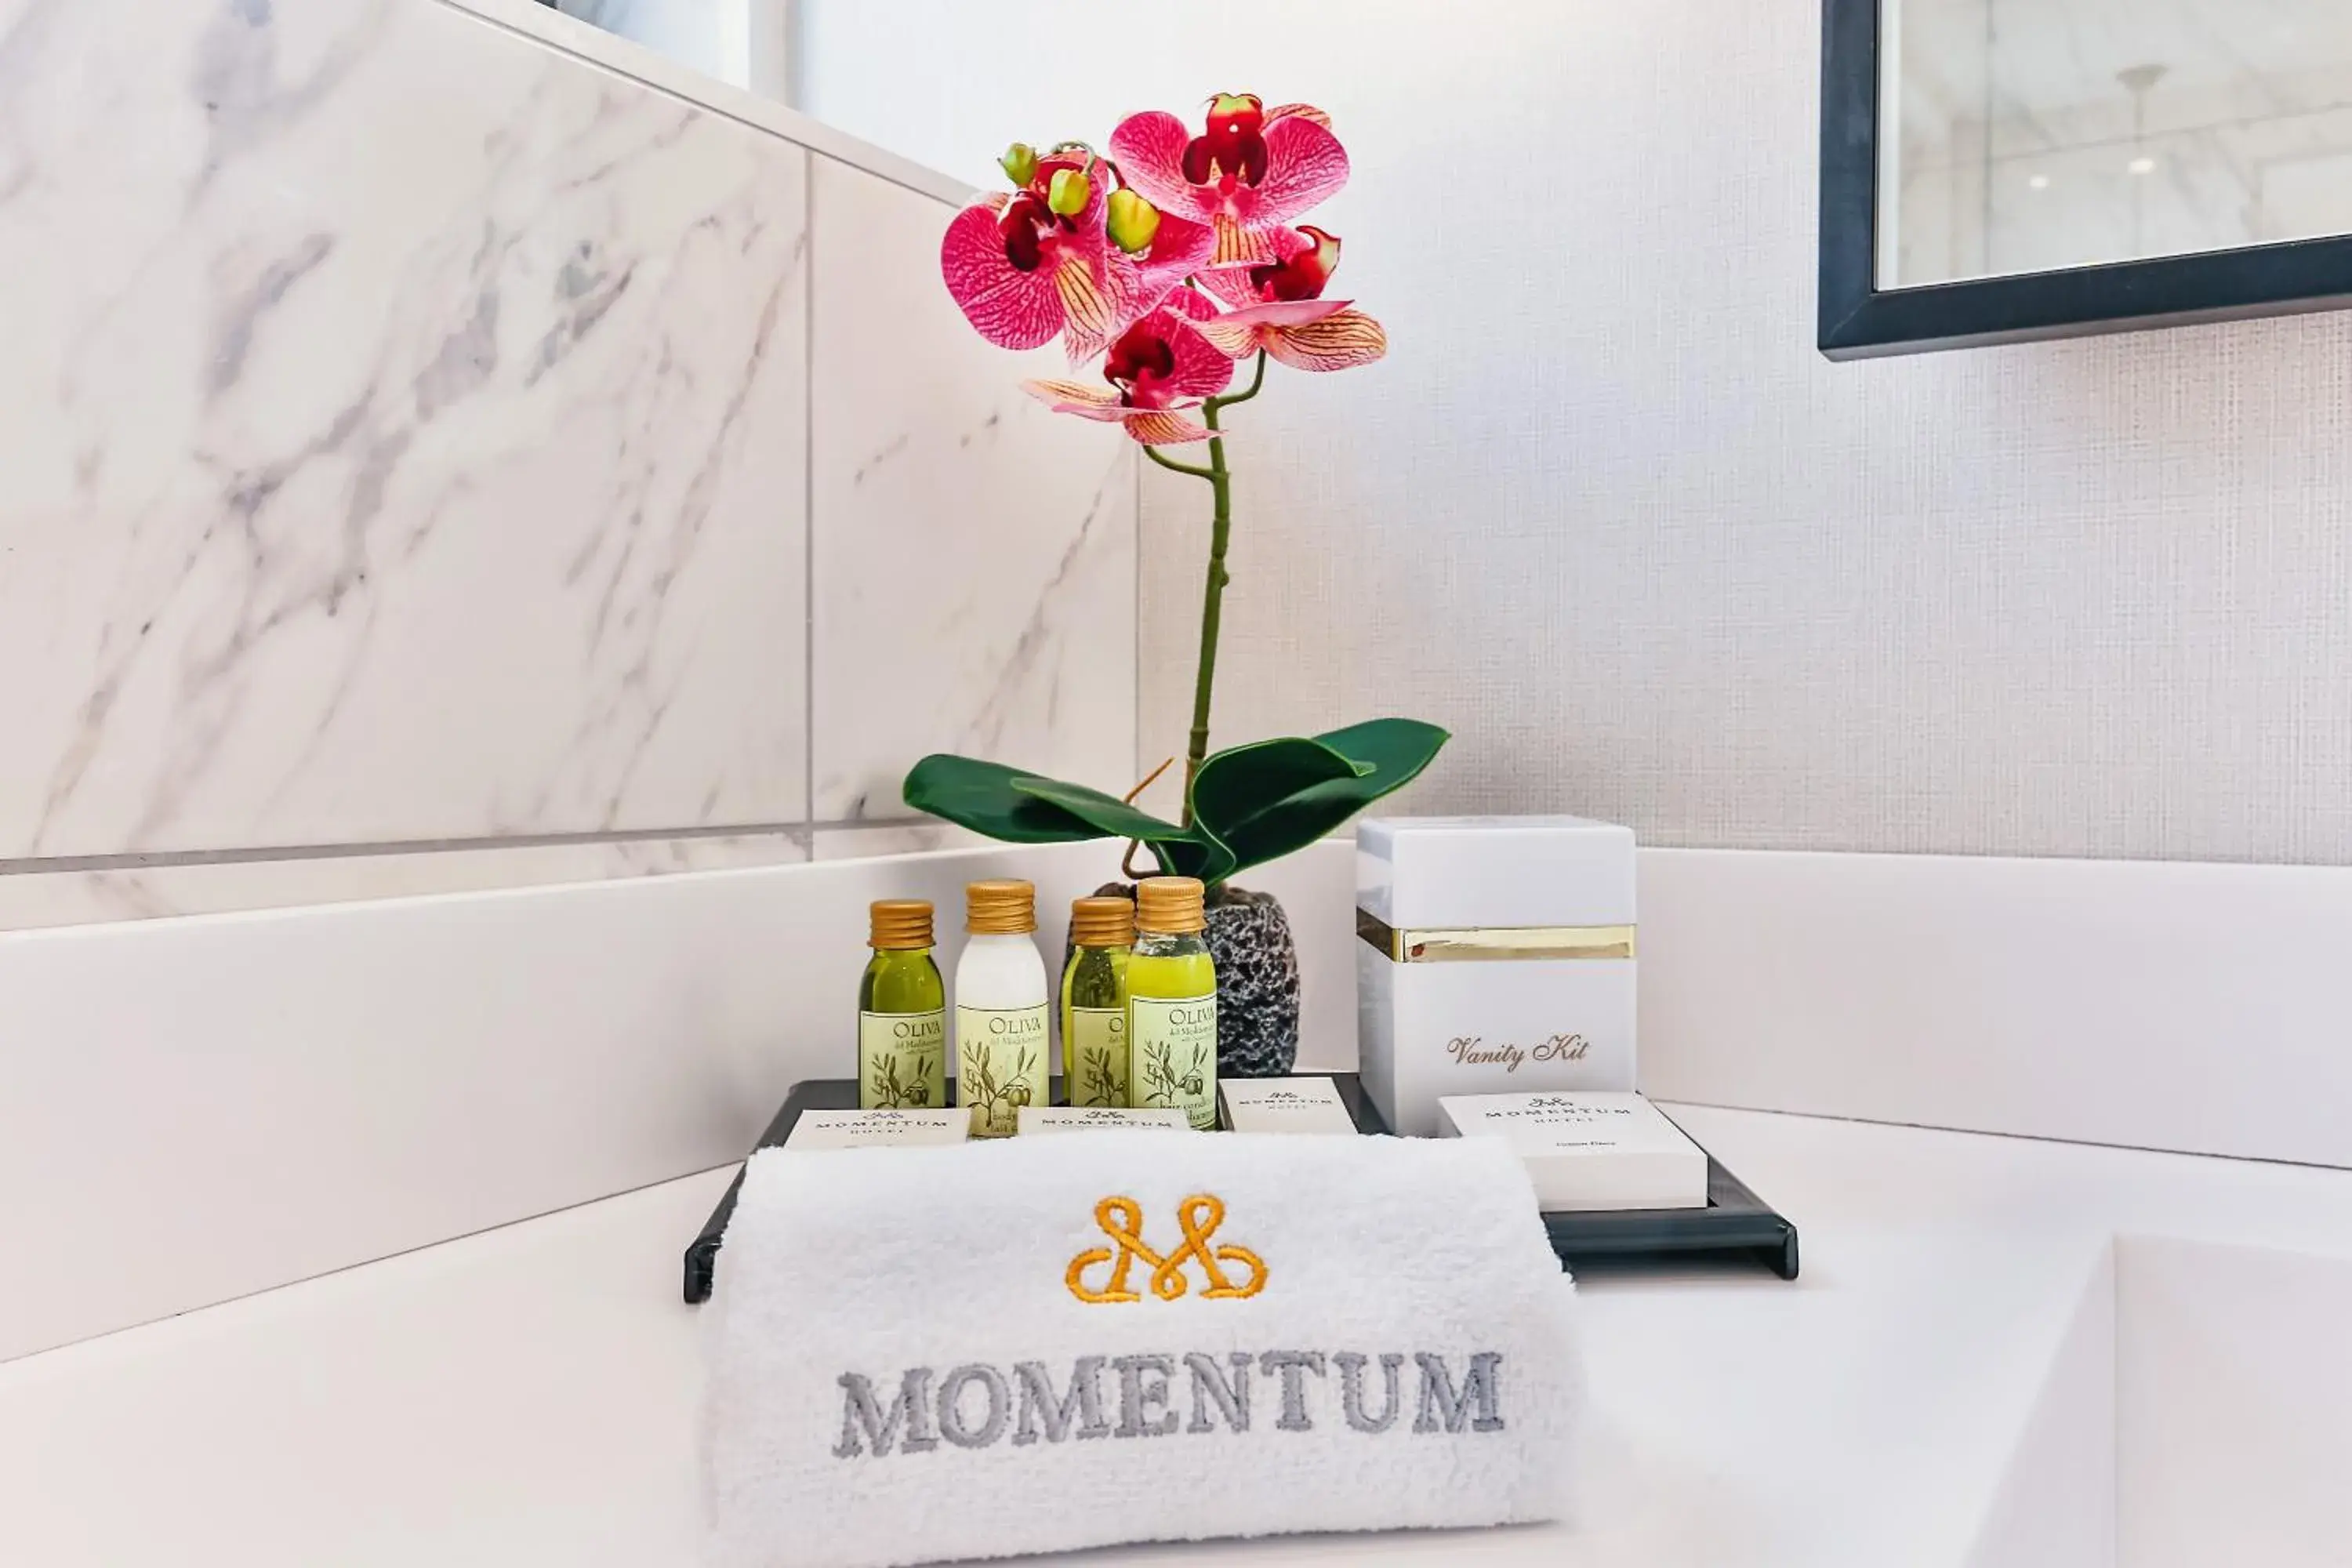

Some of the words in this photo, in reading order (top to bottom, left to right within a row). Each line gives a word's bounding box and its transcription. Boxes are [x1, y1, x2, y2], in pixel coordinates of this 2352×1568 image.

[1169, 1007, 1214, 1025] OLIVA
[893, 1021, 941, 1038] OLIVA
[989, 1017, 1042, 1034] OLIVA
[1446, 1036, 1526, 1073] Vanity
[1532, 1034, 1590, 1061] Kit
[1485, 1108, 1632, 1118] MOMENTUM
[815, 1120, 948, 1129] MOMENTUM
[1041, 1118, 1173, 1127] MOMENTUM
[832, 1349, 1505, 1460] MOMENTUM
